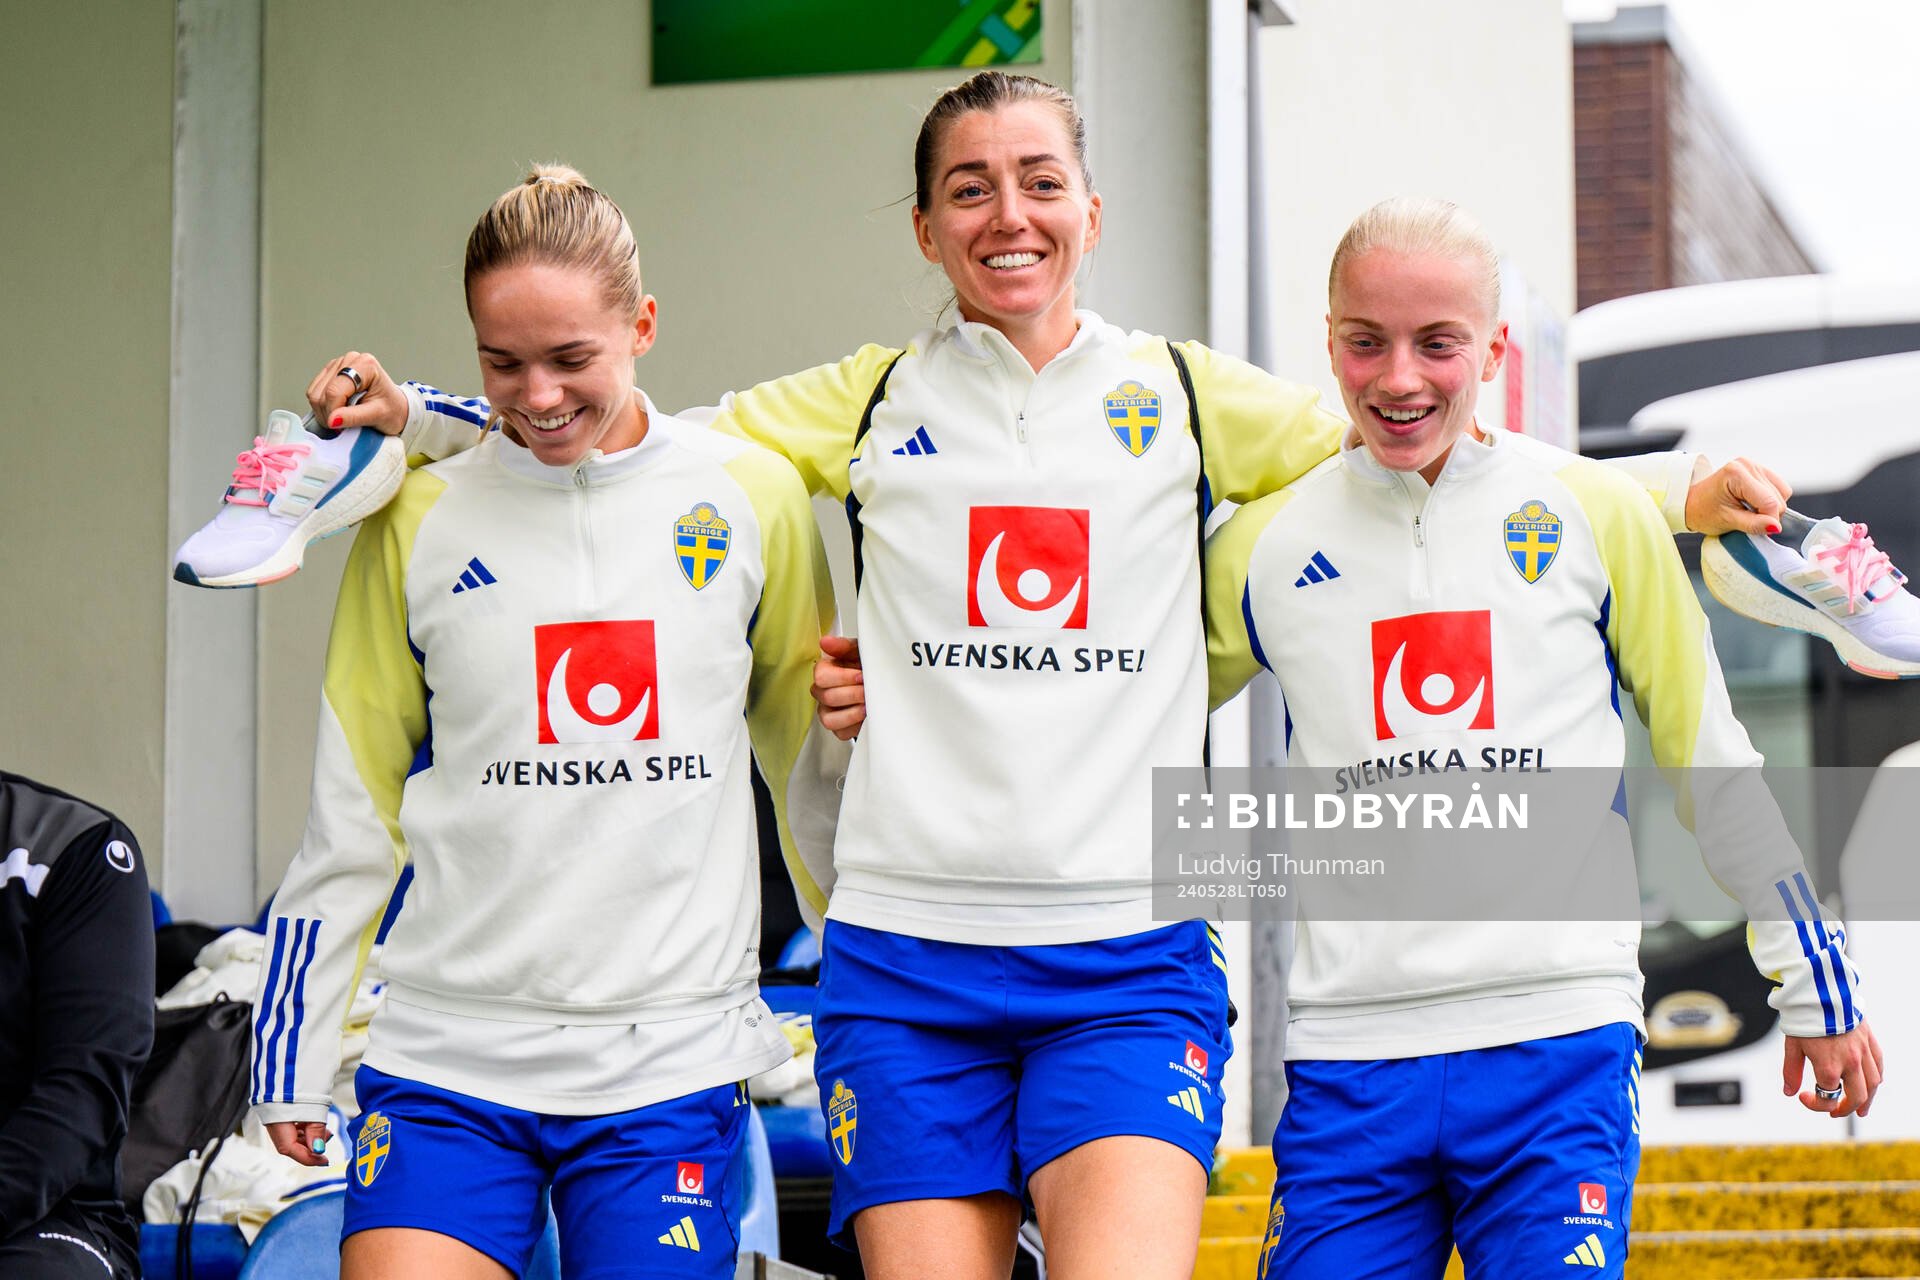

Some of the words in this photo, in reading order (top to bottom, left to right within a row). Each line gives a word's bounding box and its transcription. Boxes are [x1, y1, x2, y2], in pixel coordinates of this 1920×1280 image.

[682, 525, 723, 537] SVERIGE
[1512, 523, 1553, 531] SVERIGE
[911, 641, 1061, 672] SVENSKA
[481, 759, 633, 785] SVENSKA
[645, 754, 712, 782] SPEL
[1335, 748, 1468, 794] SVENSKA
[1480, 747, 1552, 774] SPEL
[661, 1194, 699, 1205] SVENSKA
[1563, 1216, 1603, 1226] SVENSKA
